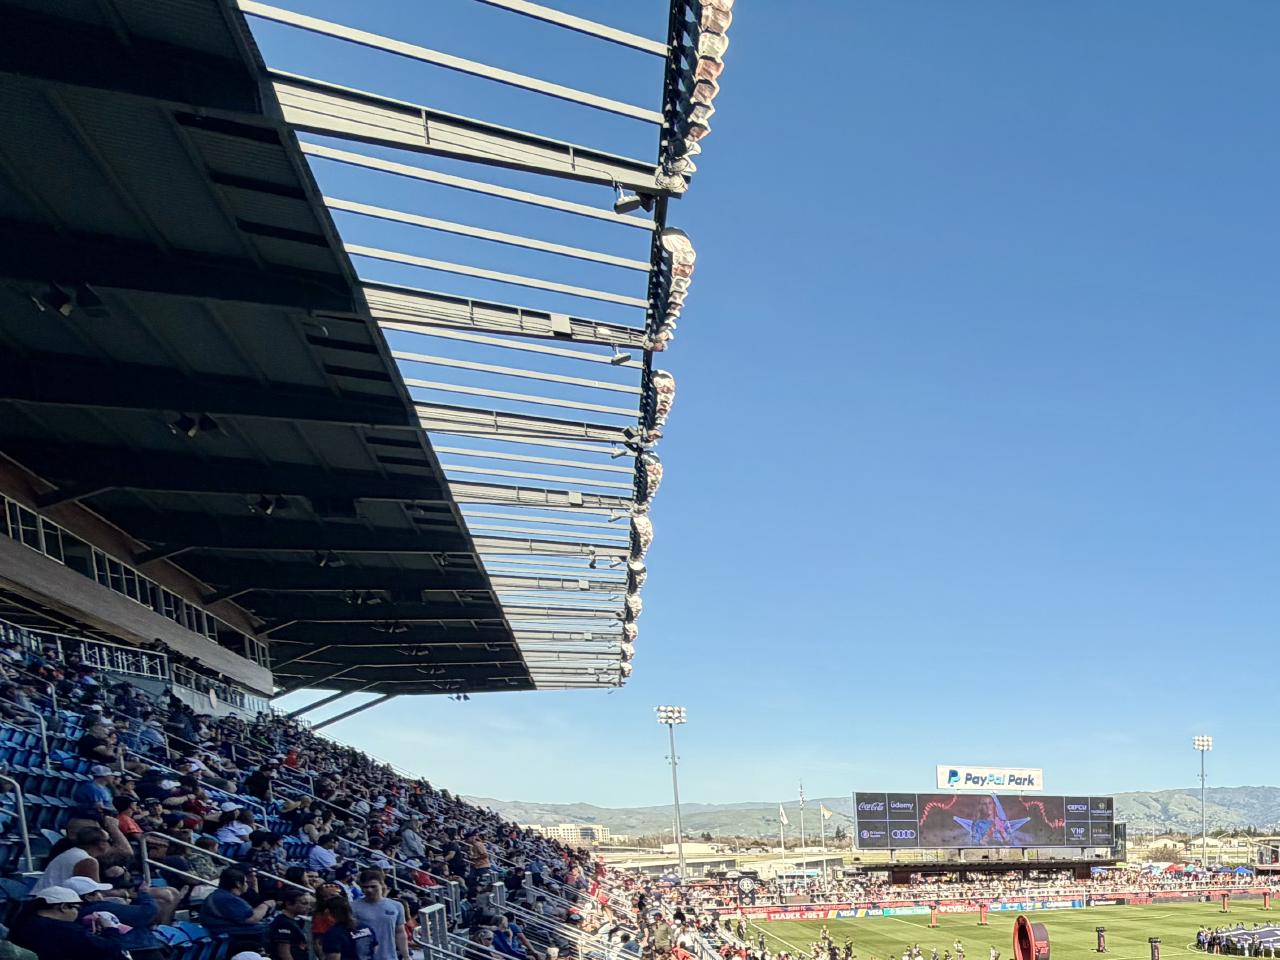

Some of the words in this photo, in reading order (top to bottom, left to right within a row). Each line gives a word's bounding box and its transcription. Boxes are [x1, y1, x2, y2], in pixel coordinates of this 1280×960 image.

[965, 773, 1005, 786] PayPal
[1008, 774, 1034, 786] Park
[840, 910, 855, 918] VISA
